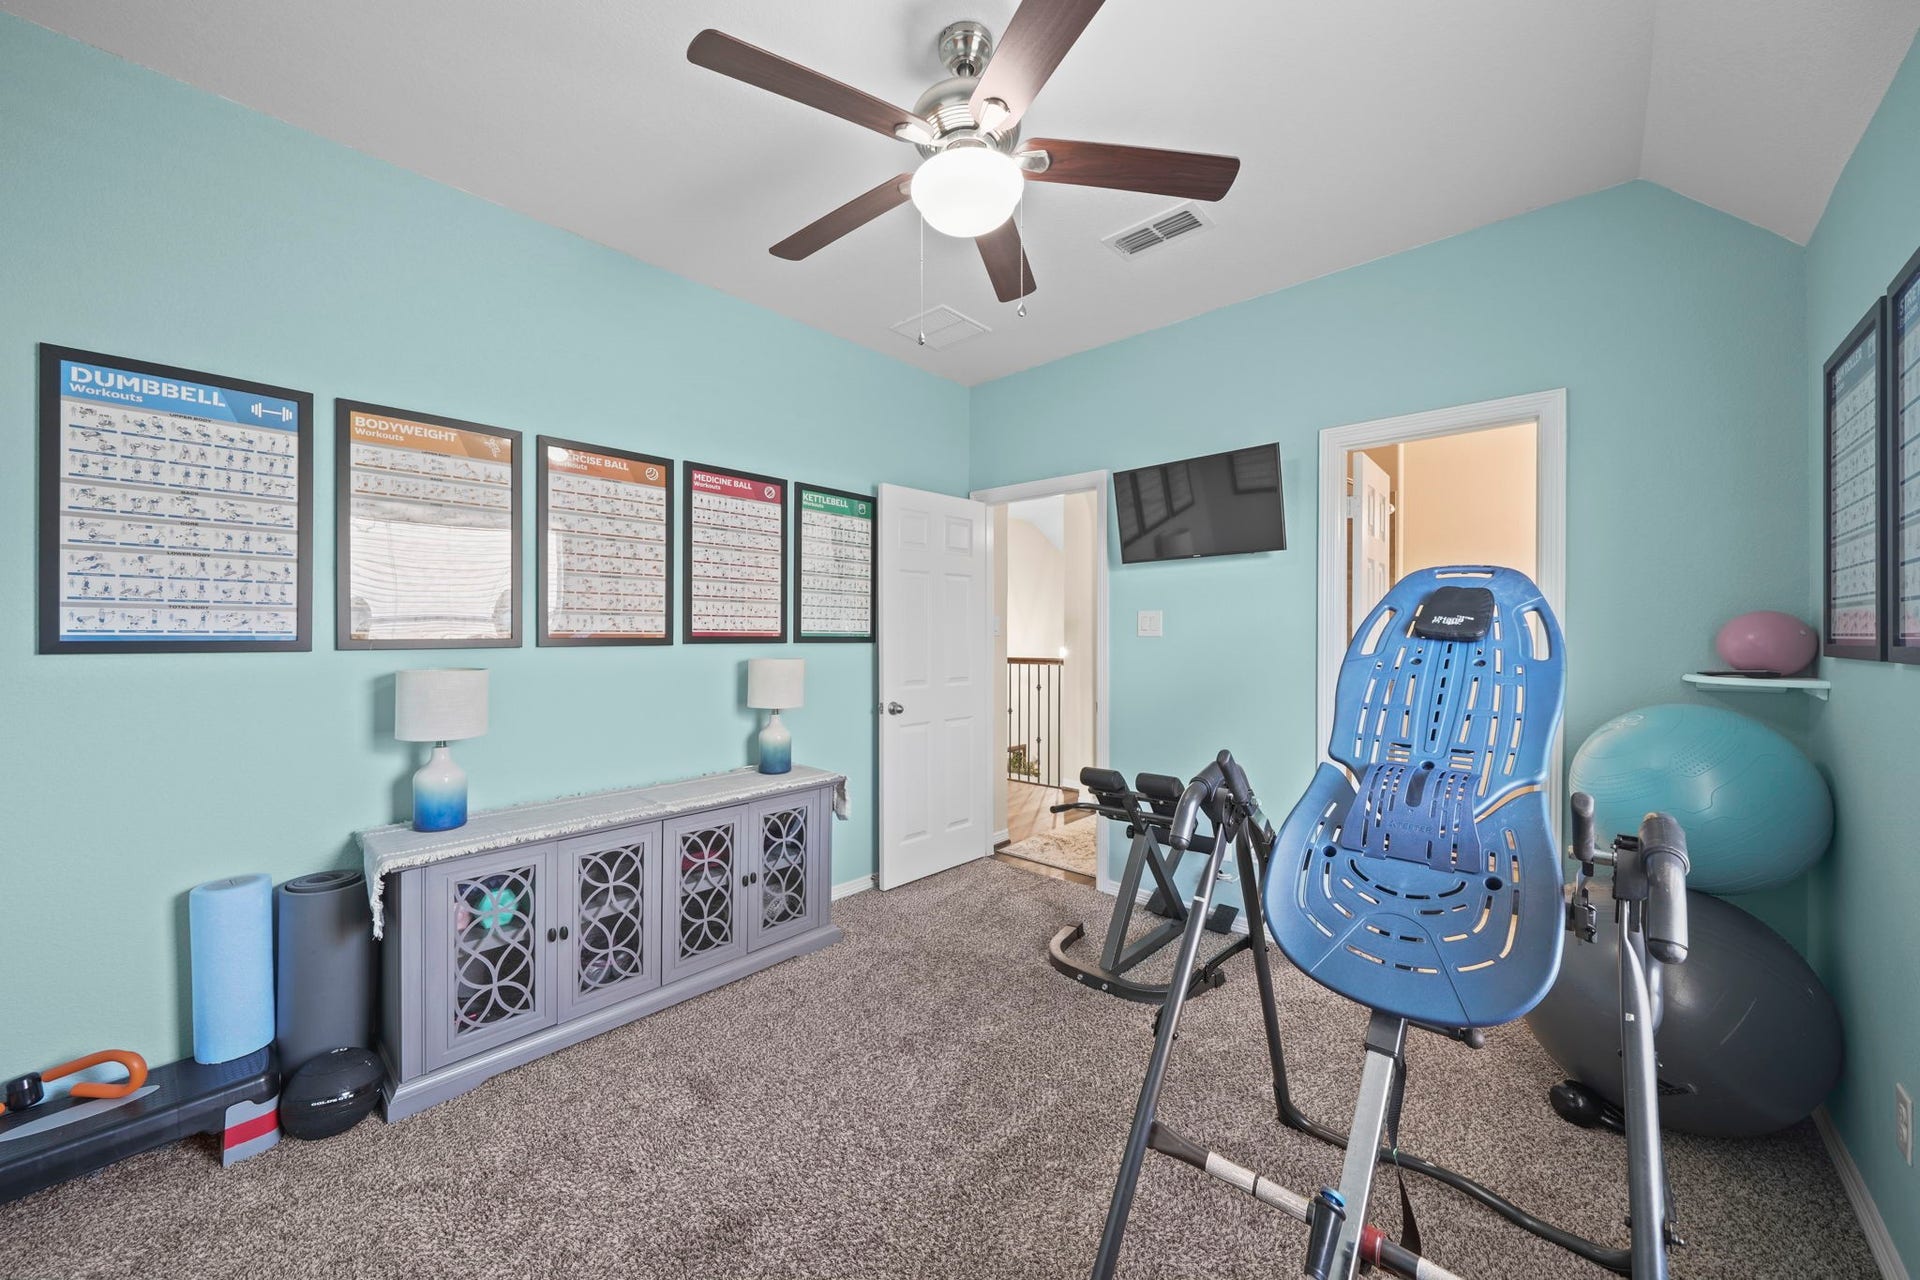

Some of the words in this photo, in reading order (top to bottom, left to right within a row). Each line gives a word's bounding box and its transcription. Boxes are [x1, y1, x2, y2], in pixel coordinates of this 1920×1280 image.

[69, 382, 143, 403] Workouts
[71, 366, 226, 407] DUMBBELL
[354, 427, 405, 441] Workouts
[355, 416, 457, 442] BODYWEIGHT
[604, 459, 630, 471] BALL
[693, 481, 721, 490] Workouts
[694, 473, 733, 487] MEDICINE
[733, 480, 752, 490] BALL
[803, 492, 849, 508] KETTLEBELL
